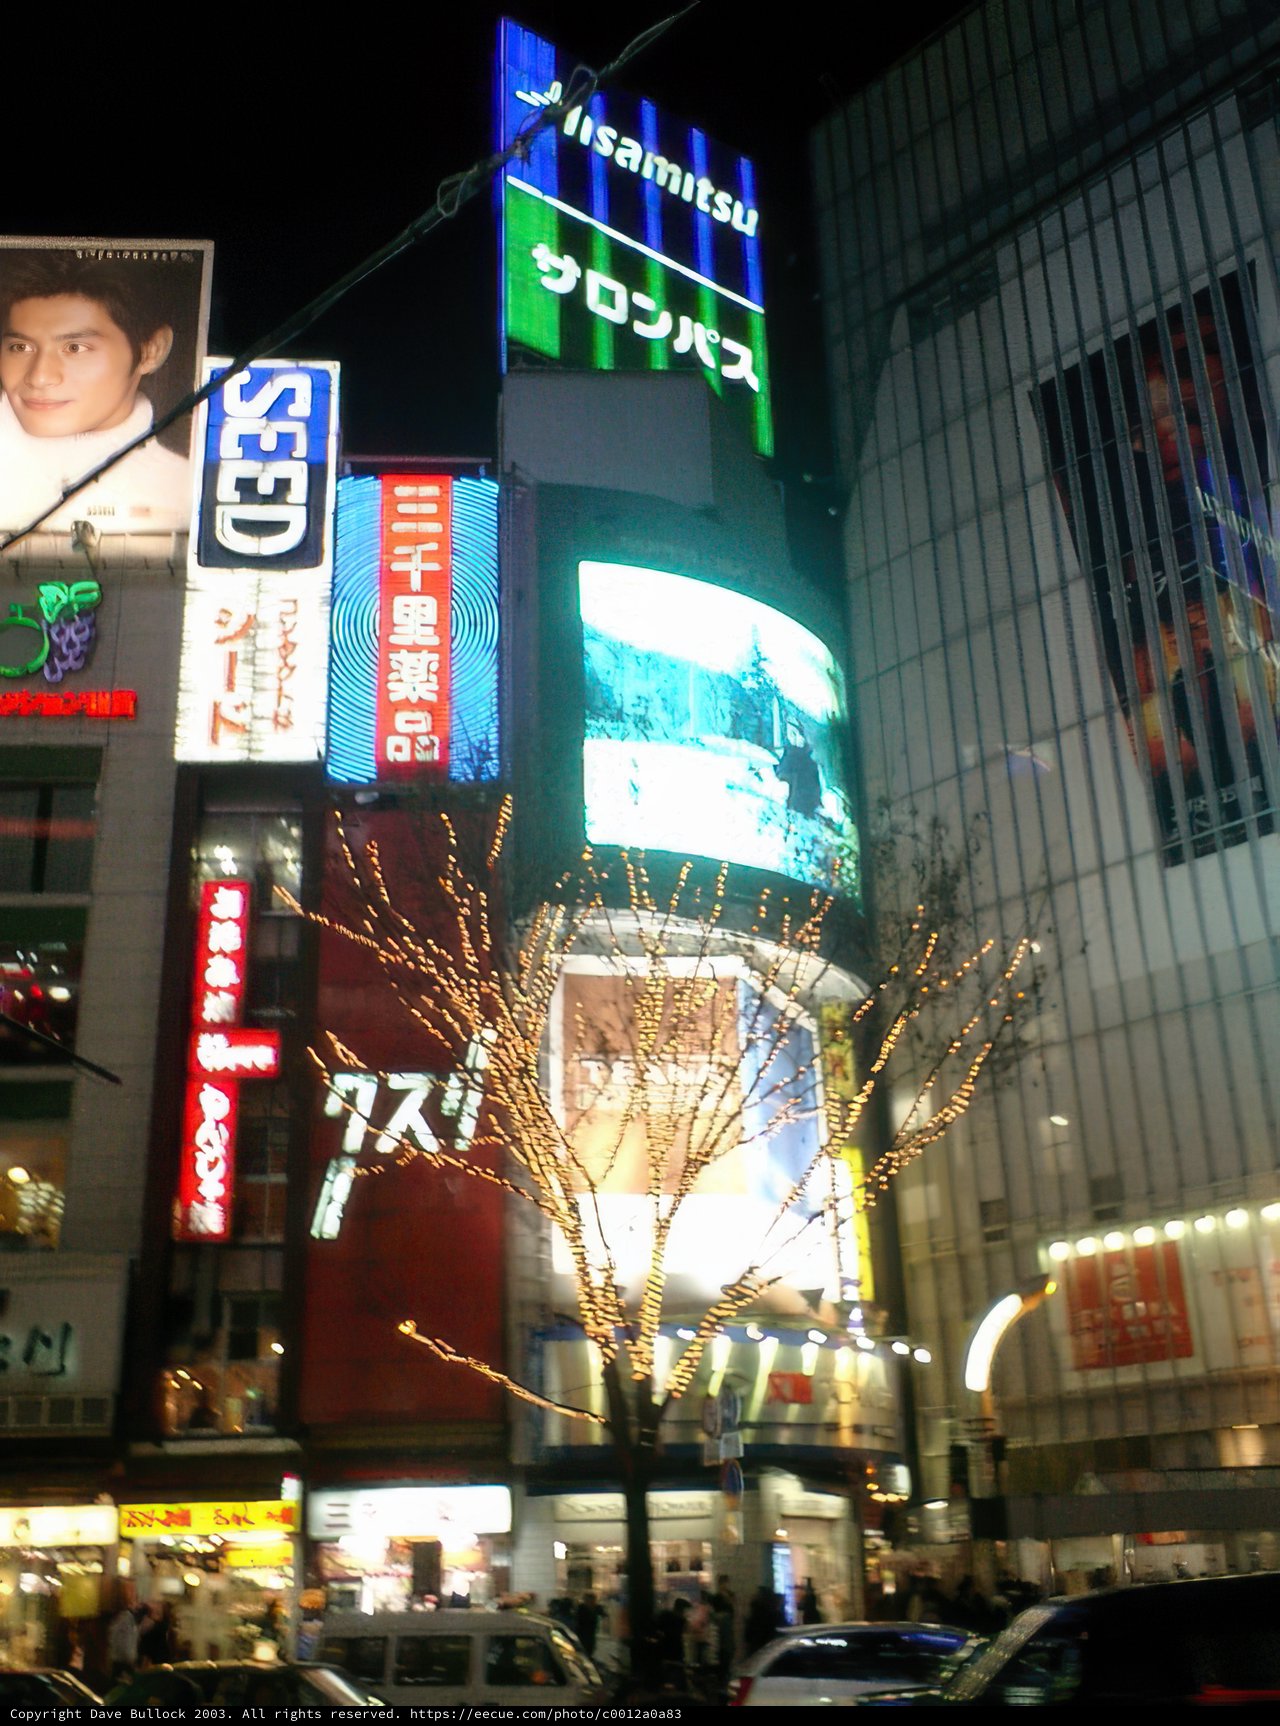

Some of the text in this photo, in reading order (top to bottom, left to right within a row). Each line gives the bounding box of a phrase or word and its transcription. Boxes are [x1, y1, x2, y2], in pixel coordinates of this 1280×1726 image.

[532, 243, 760, 393] サロンパス
[215, 370, 313, 557] SEED
[386, 484, 444, 763] 三千里薬品
